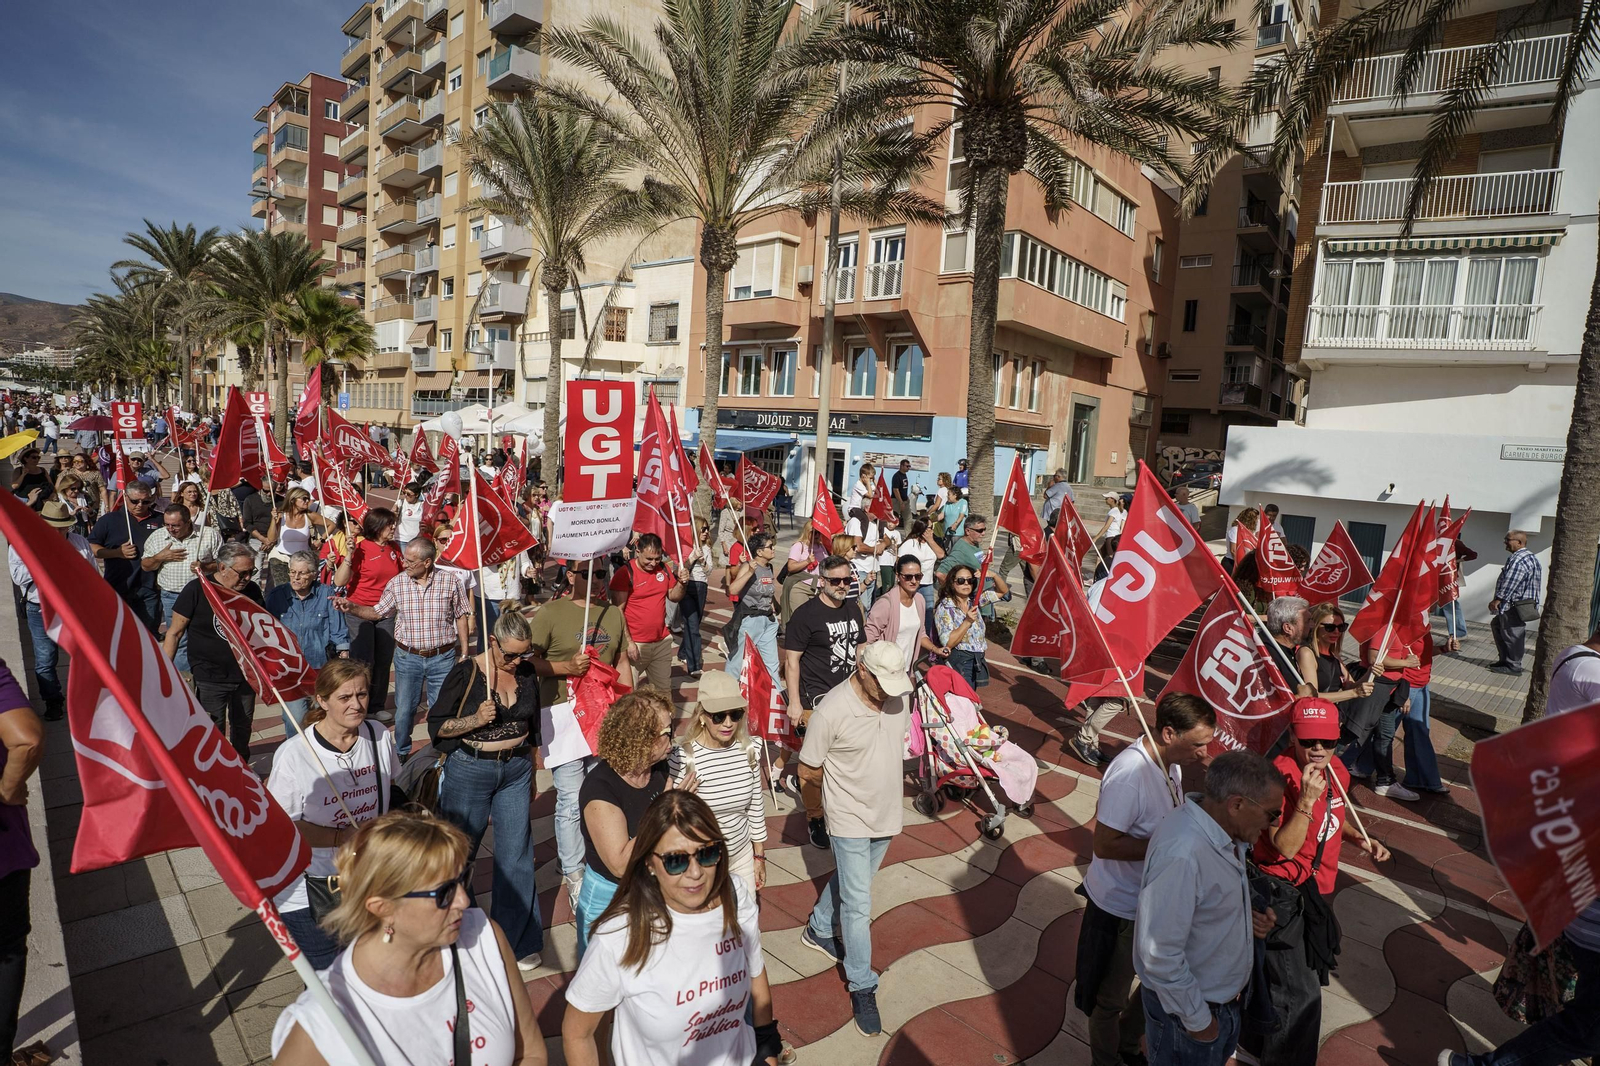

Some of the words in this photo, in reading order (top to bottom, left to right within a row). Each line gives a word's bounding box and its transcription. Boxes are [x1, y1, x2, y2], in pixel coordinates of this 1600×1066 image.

[117, 404, 138, 439] UGT
[757, 414, 792, 426] DUQUE
[798, 416, 813, 427] DE
[579, 389, 622, 498] UGT
[571, 518, 595, 526] MORENO
[354, 765, 371, 778] UGT
[324, 796, 339, 806] Lo
[342, 784, 378, 801] Primero
[715, 937, 737, 956] UGT
[676, 989, 695, 1006] Lo
[684, 990, 748, 1032] Sanidad
[682, 1017, 741, 1048] Pública
